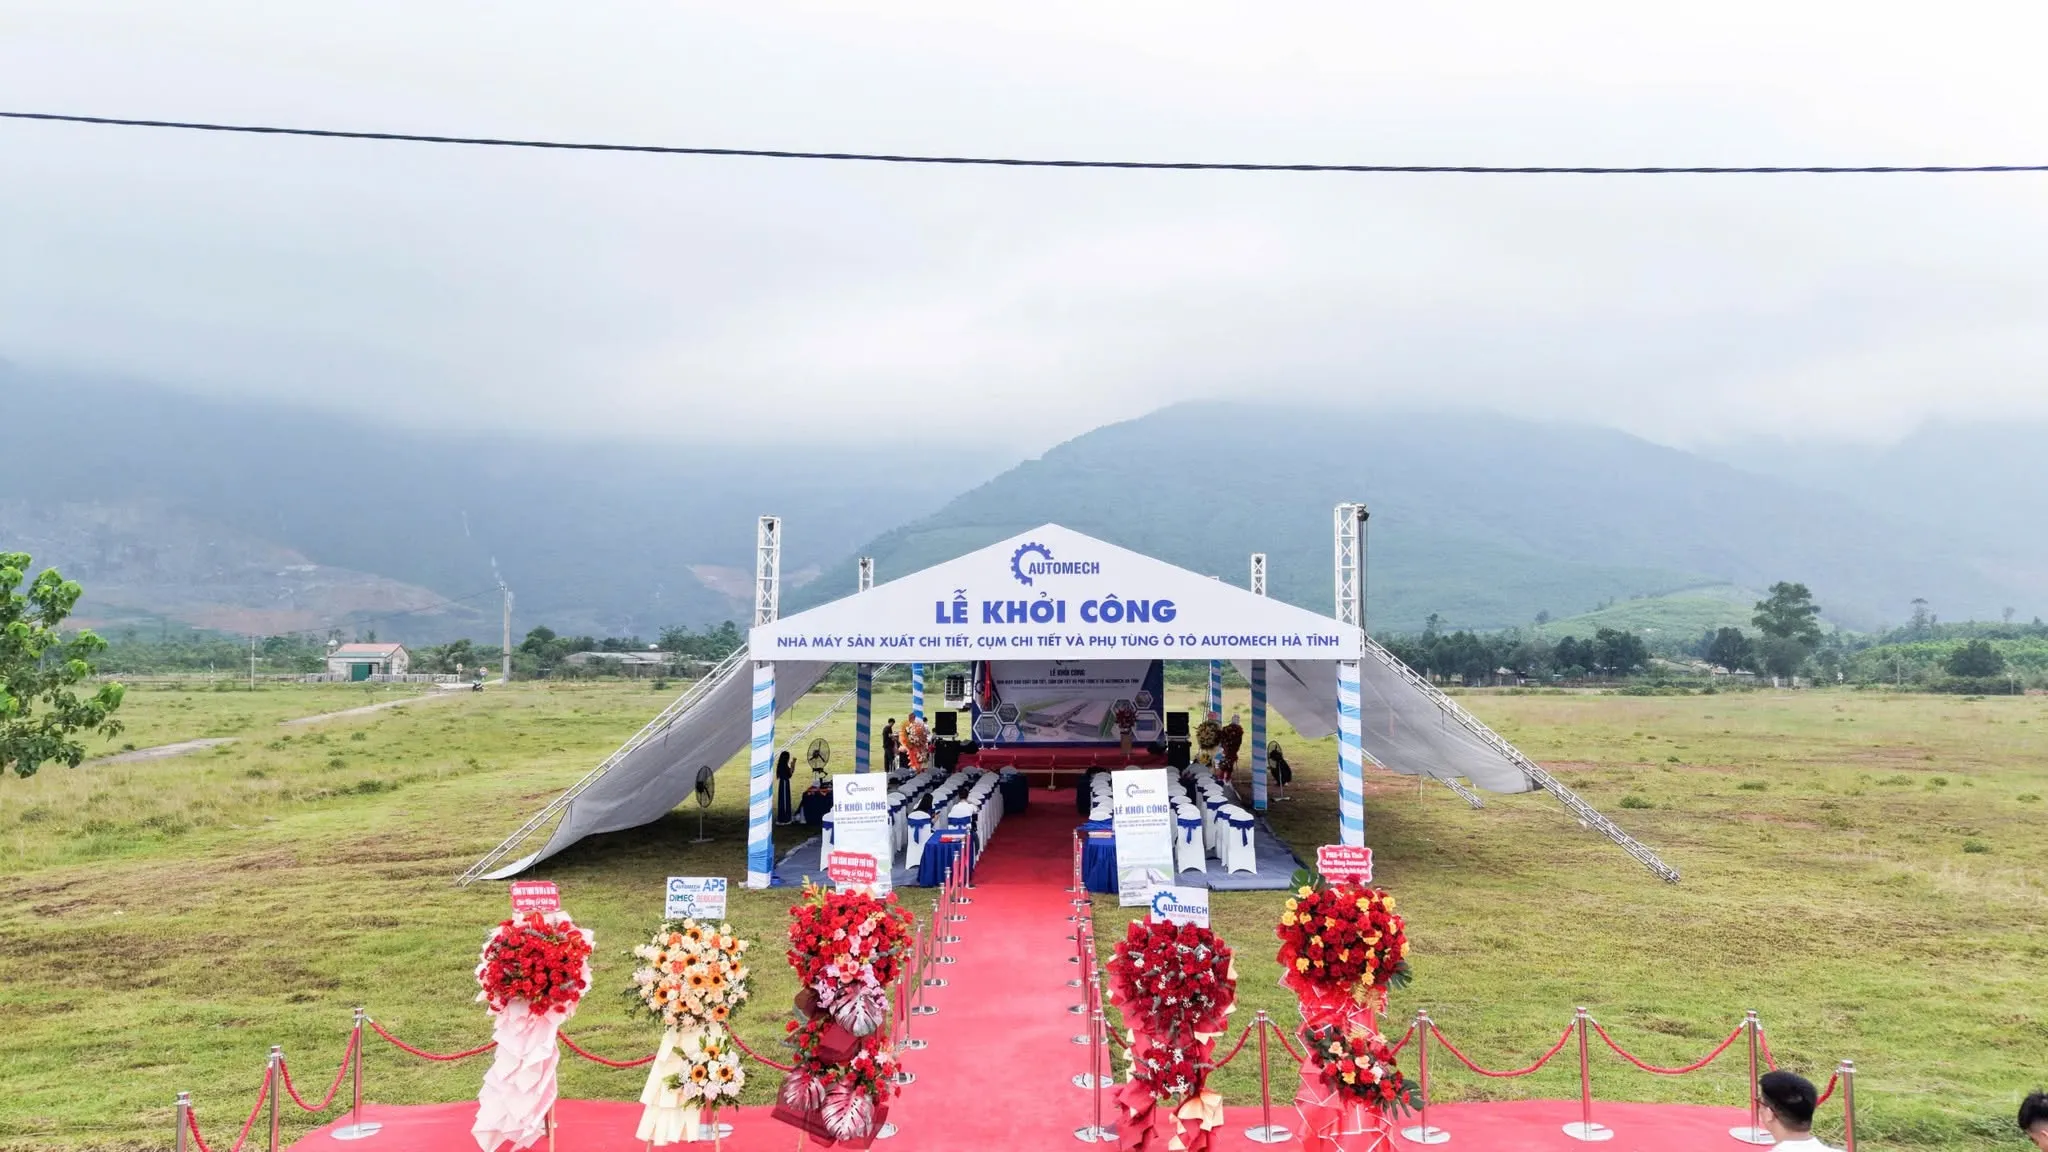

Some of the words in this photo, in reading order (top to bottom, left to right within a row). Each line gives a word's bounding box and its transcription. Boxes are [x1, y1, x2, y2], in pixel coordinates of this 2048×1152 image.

[1028, 562, 1100, 575] AUTOMECH
[935, 589, 968, 624] LỄ
[982, 592, 1066, 624] KHỞI
[1080, 593, 1177, 623] CÔNG
[777, 634, 807, 647] NHÀ
[812, 634, 843, 647] MÁY
[847, 633, 875, 647] SẢN
[880, 633, 915, 647] XUẤT
[919, 636, 941, 647] CHI
[945, 633, 973, 649] TIẾT,
[977, 636, 1007, 650] CỤM
[1011, 636, 1033, 647] CHI
[1037, 633, 1062, 647] TIẾT
[1065, 633, 1085, 647] VÀ
[1089, 636, 1117, 649] PHỤ
[1121, 633, 1159, 647] TÙNG
[1163, 633, 1175, 646] Ô
[1179, 633, 1197, 646] TÔ
[1201, 635, 1277, 646] AUTOMECH
[1282, 633, 1302, 646] HÀ
[1306, 633, 1339, 646] TĨNH
[703, 879, 725, 891] APS
[1163, 904, 1208, 914] AUTOMECH
